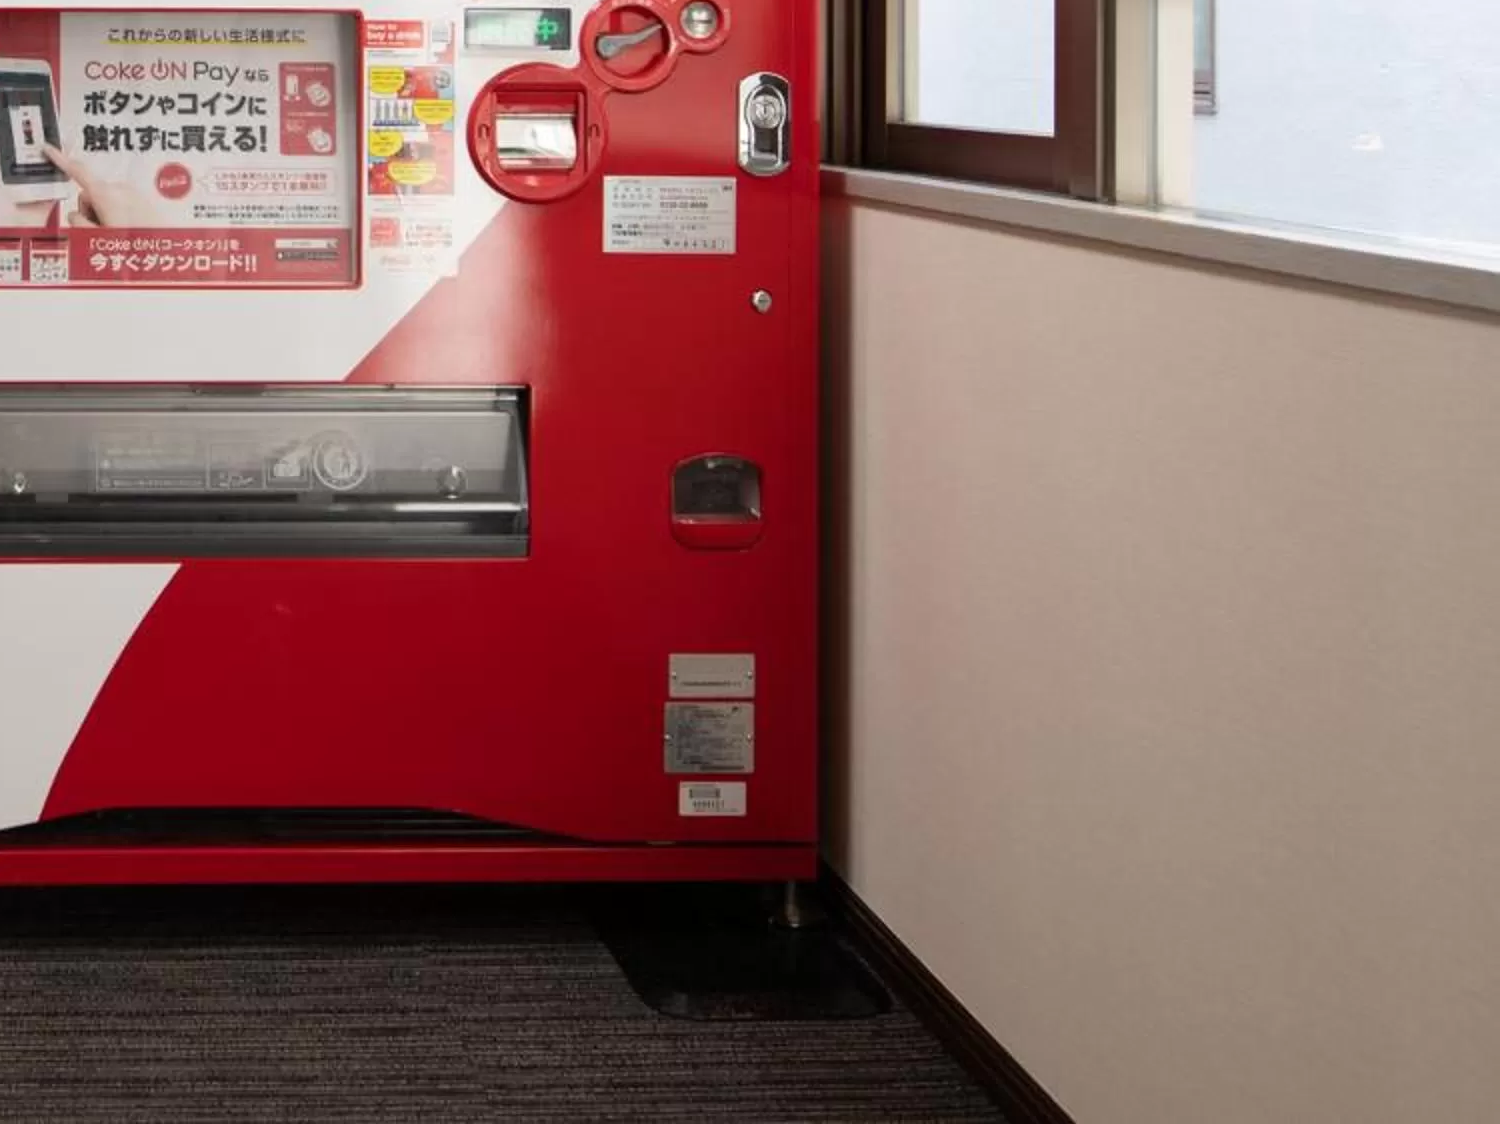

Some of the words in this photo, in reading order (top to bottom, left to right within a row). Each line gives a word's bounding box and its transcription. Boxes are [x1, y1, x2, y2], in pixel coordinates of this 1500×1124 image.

[107, 27, 305, 44] これからの新しい生活様式に
[83, 60, 146, 82] Coke
[150, 57, 189, 82] ON
[192, 61, 240, 87] Pay
[83, 91, 267, 117] ボタンやコインに
[83, 124, 268, 153] 触れずに買える!
[88, 254, 257, 273] 今すぐダウンロード!!
